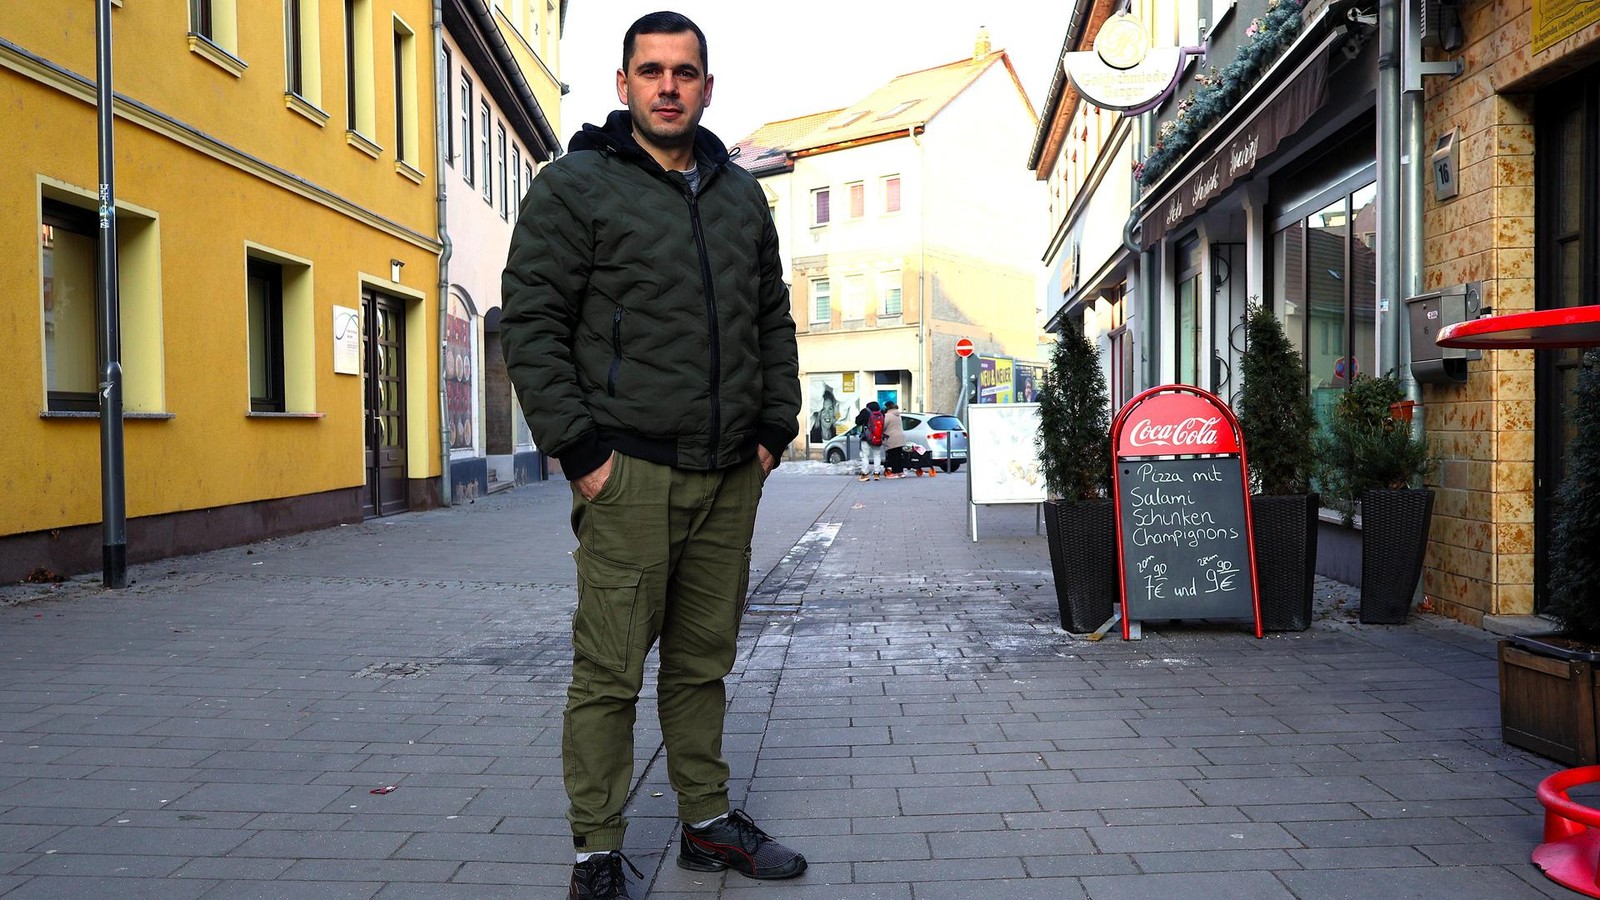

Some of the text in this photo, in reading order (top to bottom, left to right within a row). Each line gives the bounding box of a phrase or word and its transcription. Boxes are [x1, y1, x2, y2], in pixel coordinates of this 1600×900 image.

[1438, 163, 1449, 185] 16
[1130, 417, 1222, 447] Coca-Cola
[1137, 463, 1223, 483] Pizza mit
[1130, 487, 1195, 507] Salami
[1132, 508, 1215, 526] Schinken
[1132, 527, 1239, 547] Champignons
[1174, 577, 1197, 597] und
